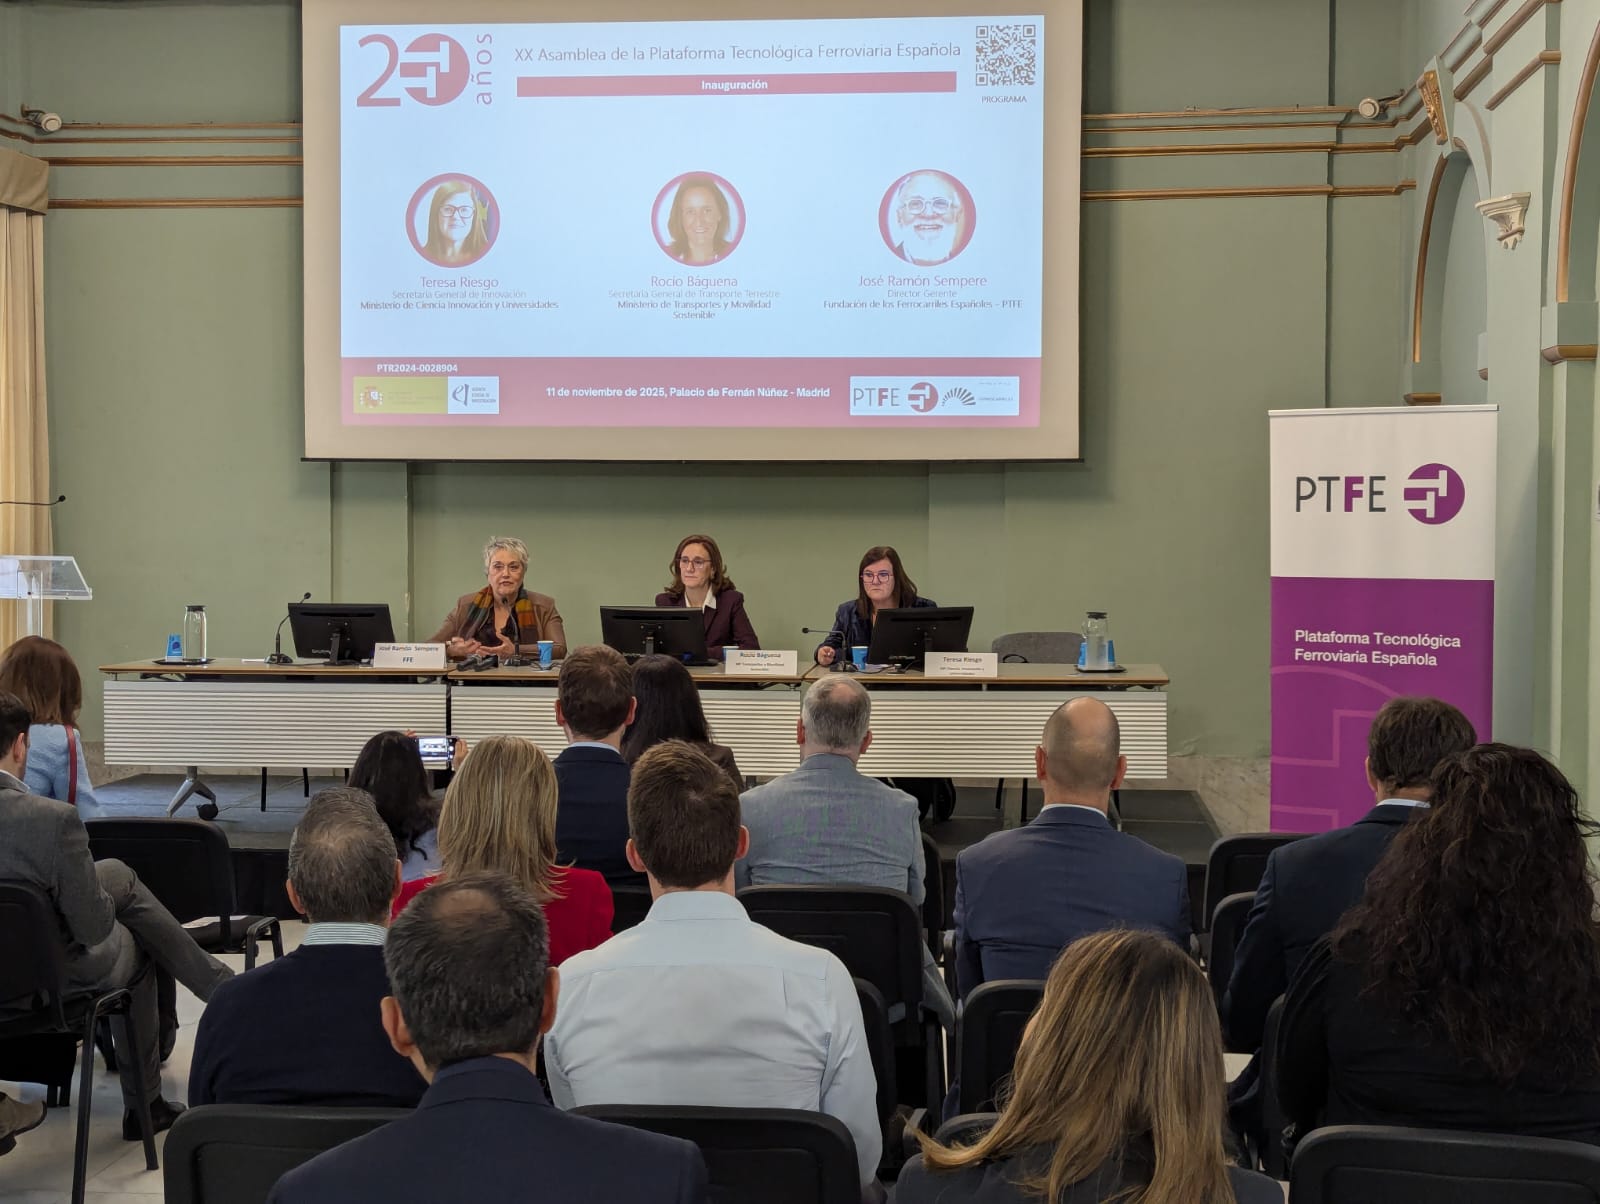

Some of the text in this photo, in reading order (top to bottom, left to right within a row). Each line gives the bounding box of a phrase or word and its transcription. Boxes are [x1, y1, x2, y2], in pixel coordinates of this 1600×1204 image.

[514, 42, 961, 61] XX Asamblea de la Plataforma Tecnológica Ferroviaria Española
[470, 34, 492, 105] años
[701, 79, 769, 92] Inauguración
[981, 95, 1028, 104] PROGRAMA
[420, 276, 499, 290] Teresa Riesgo
[687, 275, 738, 289] Báguena
[858, 274, 988, 289] José Ramón Sempere
[434, 290, 467, 299] General
[469, 290, 480, 299] de
[481, 289, 526, 299] Innovación
[651, 289, 683, 298] General
[685, 289, 696, 298] de
[699, 289, 743, 300] Transporte
[745, 289, 780, 298] Terrestre
[888, 289, 958, 298] Director Gerente
[360, 301, 401, 310] Ministerio
[403, 301, 414, 309] de
[416, 300, 446, 309] Ciencia
[448, 300, 493, 309] Innovación
[502, 300, 559, 309] Universidades
[617, 300, 658, 309] Ministerio
[660, 300, 671, 309] de
[674, 300, 721, 310] Transportes
[731, 300, 771, 309] Movilidad
[823, 300, 867, 309] Fundación
[869, 300, 881, 309] de
[882, 300, 894, 309] los
[897, 300, 949, 309] Ferrocarriles
[951, 299, 993, 310] Españoles
[1002, 300, 1022, 309] PTFE
[673, 311, 716, 319] Sostenible
[376, 363, 459, 373] PTR2024-0028904
[546, 387, 555, 397] 11
[557, 386, 570, 397] de
[572, 386, 623, 397] noviembre
[625, 386, 637, 397] de
[640, 387, 668, 399] 2025,
[670, 387, 705, 397] Palacio
[707, 387, 720, 397] de
[722, 387, 755, 397] Fernán
[758, 387, 788, 397] Núñez
[797, 387, 830, 397] Madrid
[853, 387, 901, 407] PTFE
[1296, 475, 1387, 512] PTFE
[1295, 630, 1461, 650] Plataforma Tecnológica
[1295, 649, 1438, 667] Ferroviaria Española
